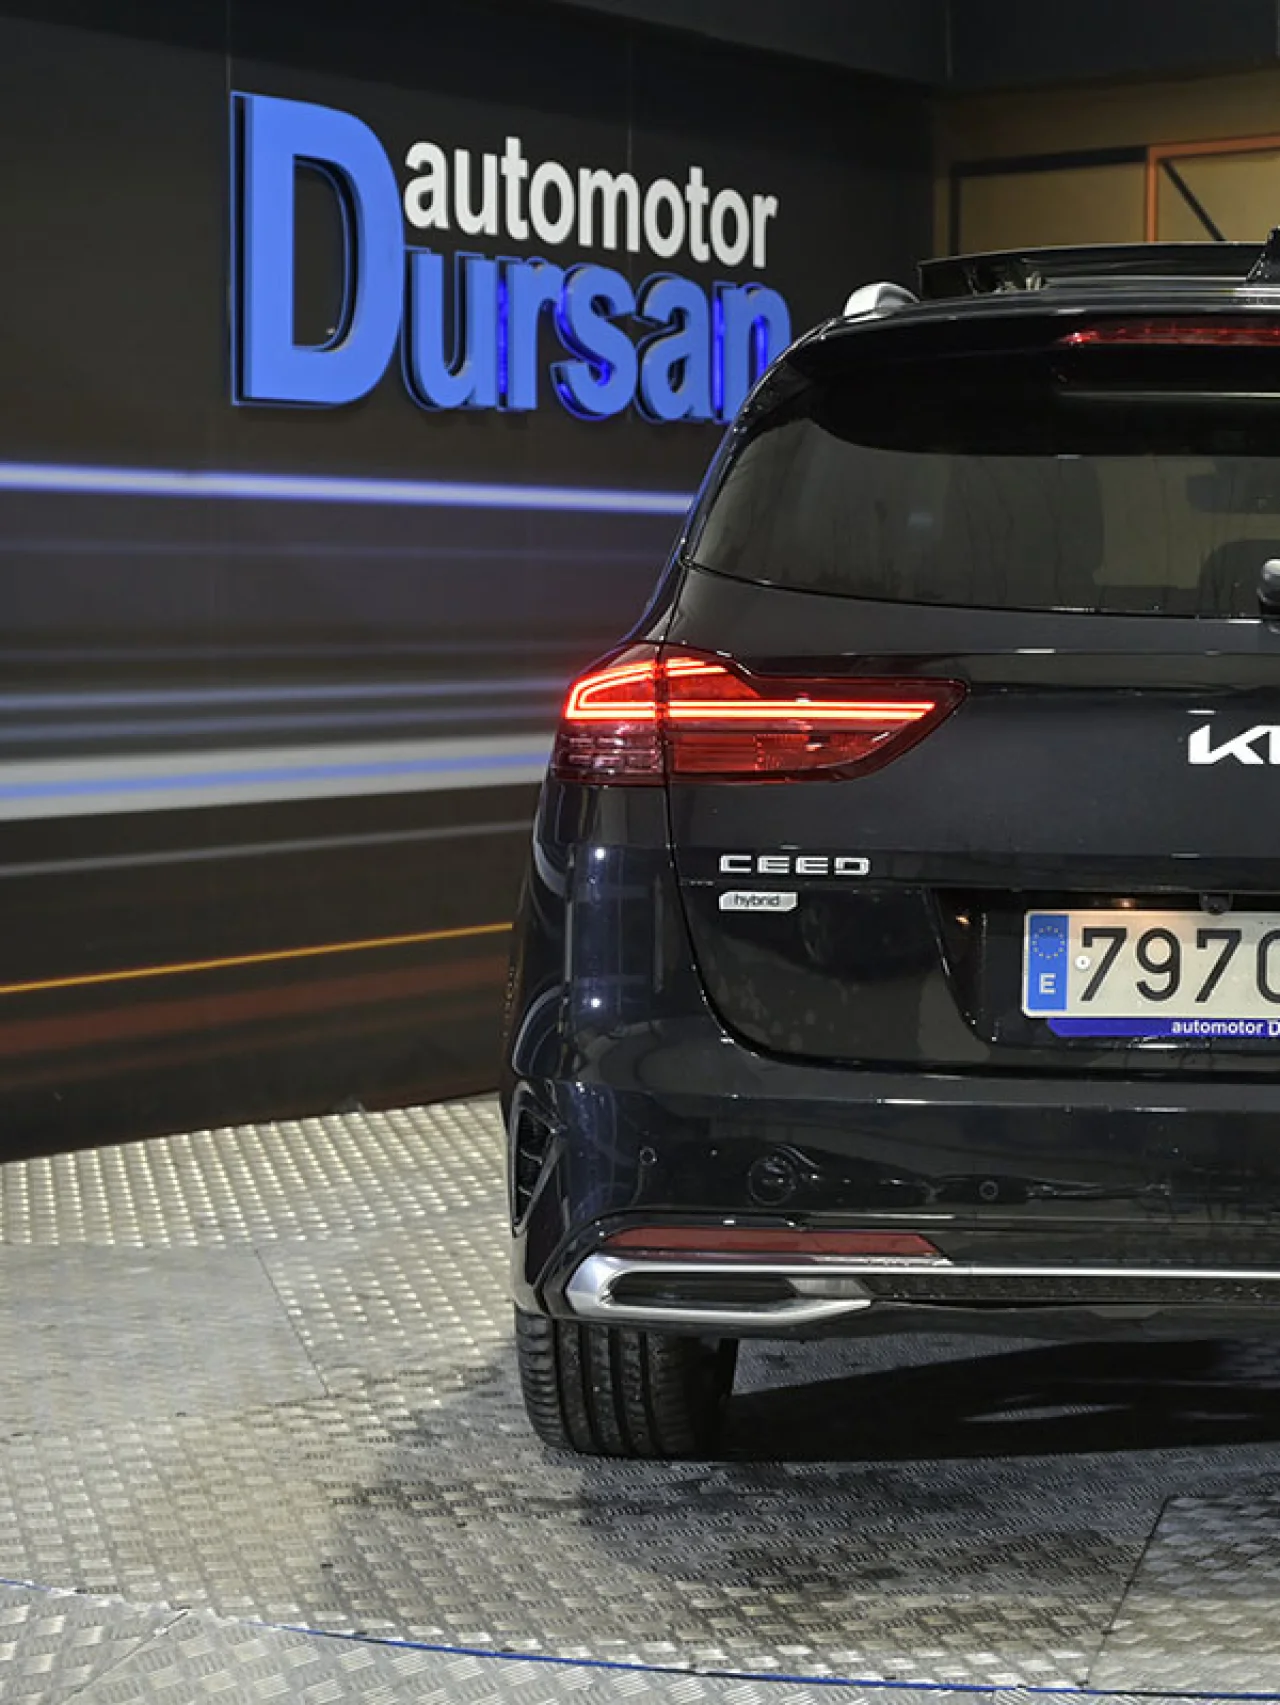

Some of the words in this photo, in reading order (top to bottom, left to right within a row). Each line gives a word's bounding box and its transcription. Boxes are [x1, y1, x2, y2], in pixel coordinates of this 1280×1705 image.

[404, 136, 778, 267] automotor
[230, 90, 791, 423] Dursan
[720, 855, 870, 875] CEED
[733, 893, 780, 908] hybrid
[1039, 972, 1056, 995] E
[1171, 1020, 1263, 1035] automotor
